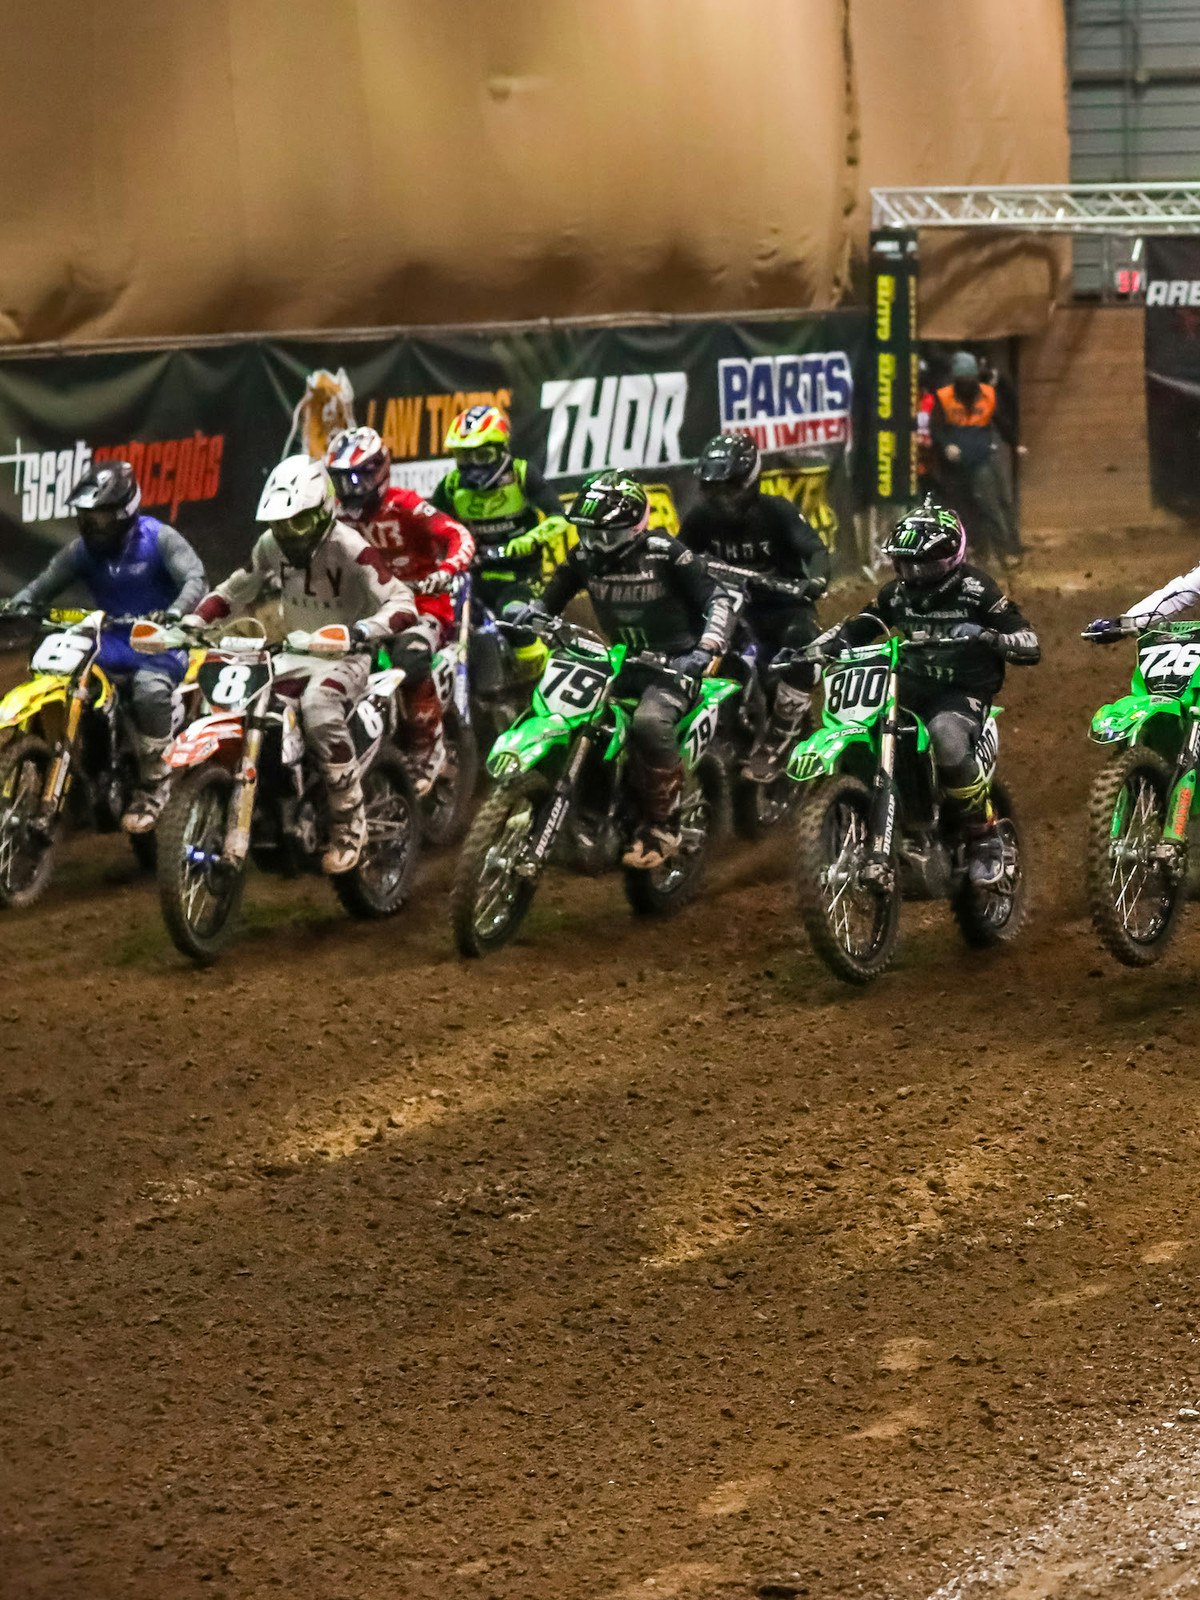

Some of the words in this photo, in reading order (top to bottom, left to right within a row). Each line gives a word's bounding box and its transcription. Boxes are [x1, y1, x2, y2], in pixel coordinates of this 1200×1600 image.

[722, 356, 850, 421] PARTS
[542, 372, 688, 479] THOR
[211, 664, 251, 704] 8
[543, 661, 604, 709] 79
[828, 667, 888, 714] 800
[357, 700, 383, 739] 8
